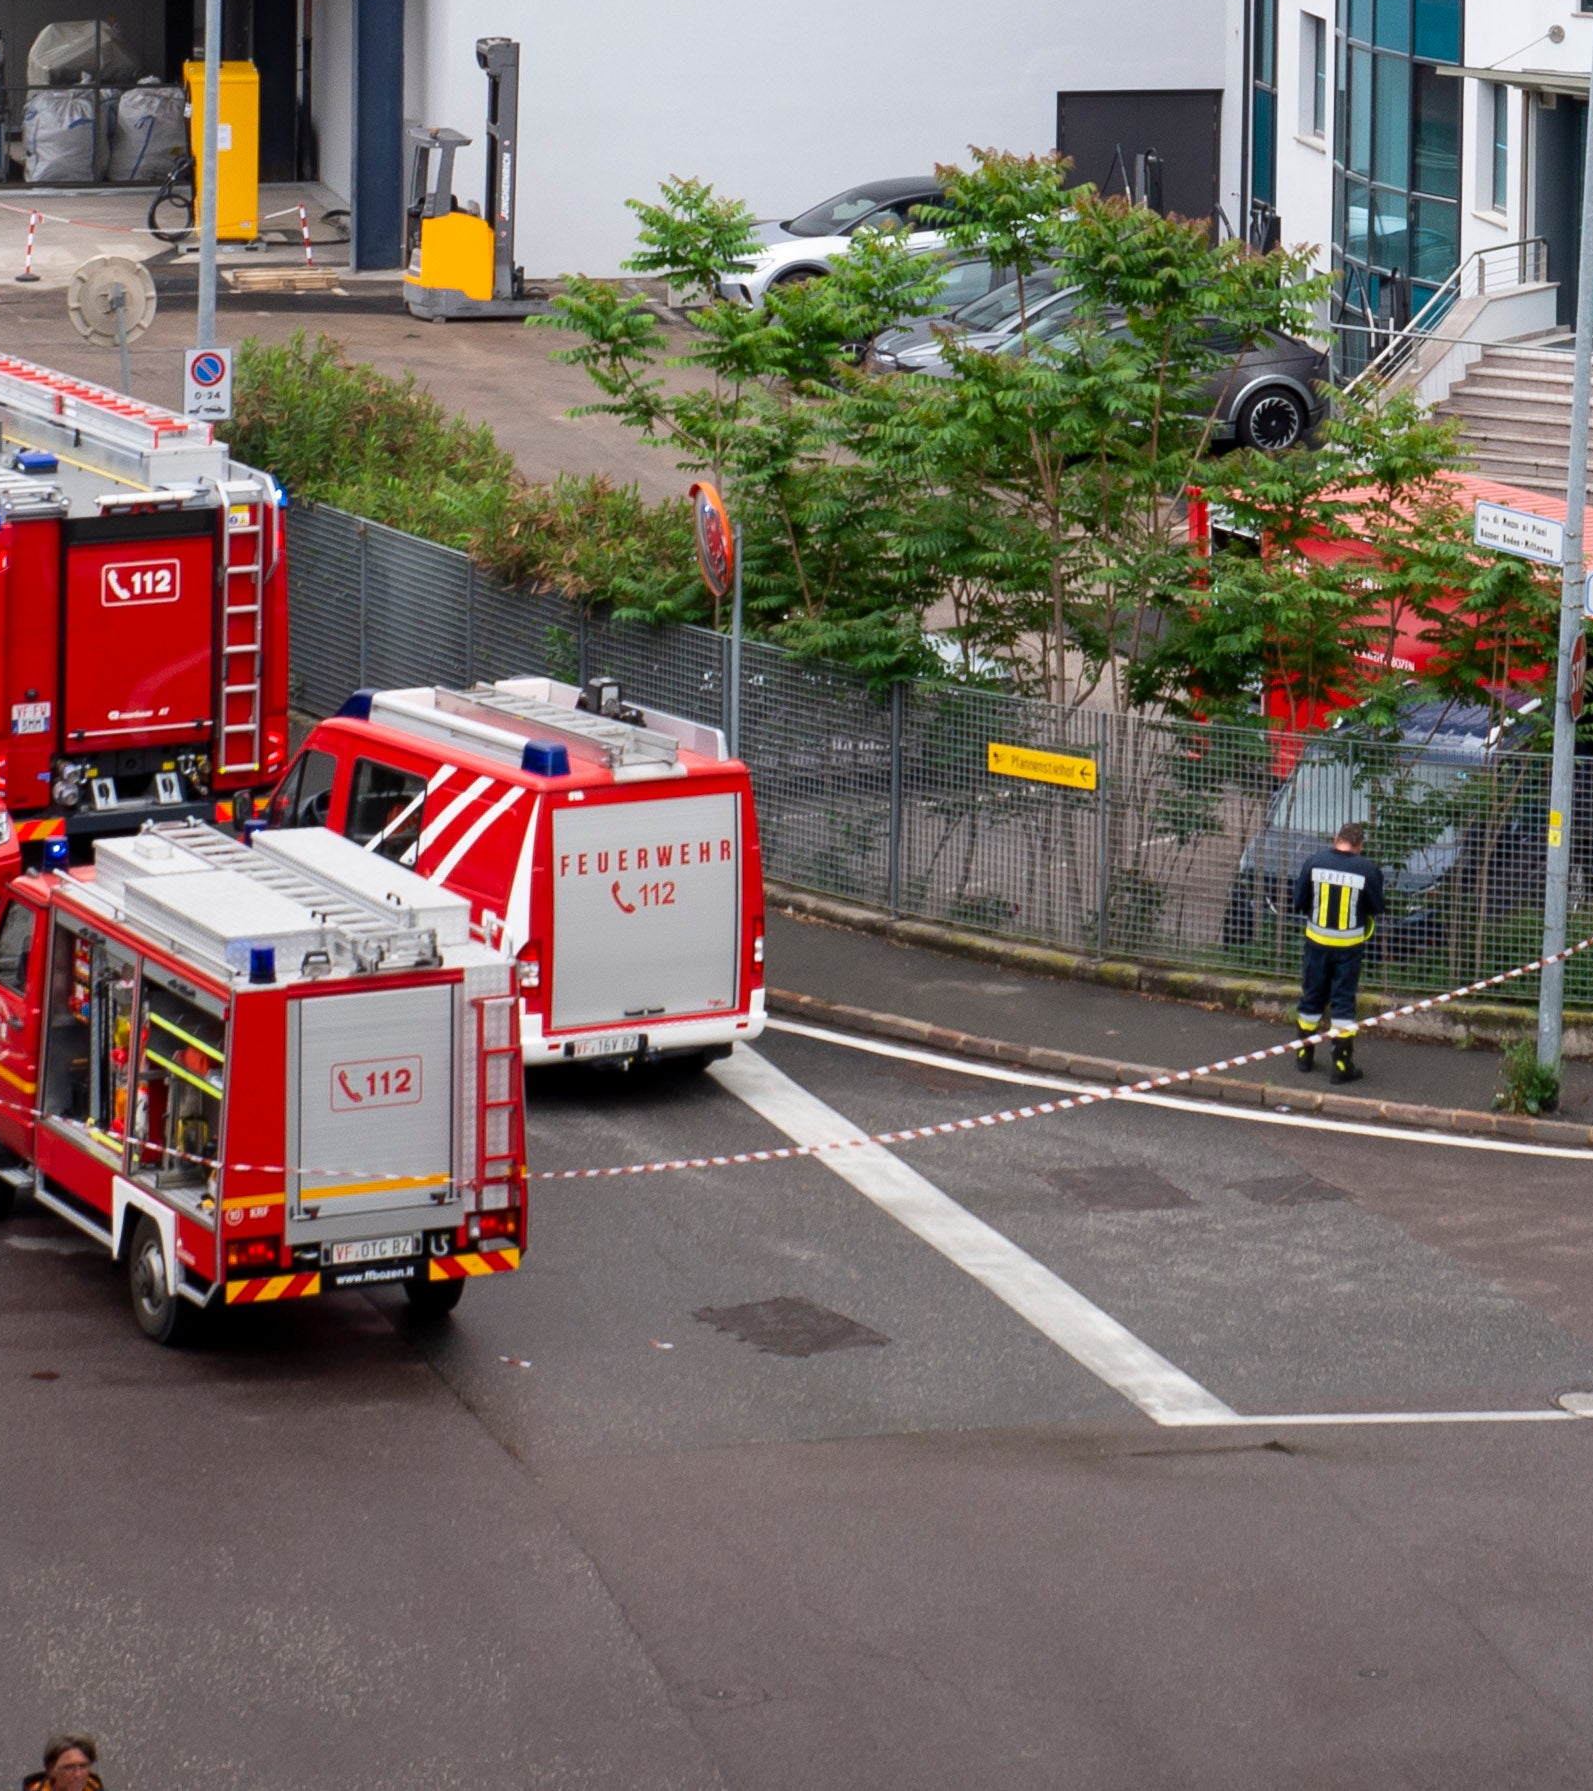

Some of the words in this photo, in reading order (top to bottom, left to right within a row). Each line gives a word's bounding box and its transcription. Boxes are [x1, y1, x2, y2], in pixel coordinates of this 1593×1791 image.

[1532, 524, 1548, 538] Piani
[131, 569, 172, 595] 112
[560, 839, 732, 877] FEUERWEHR
[639, 881, 676, 907] 112
[575, 1038, 589, 1055] VF
[622, 1035, 637, 1050] BZ
[366, 1068, 412, 1097] 112
[336, 1244, 353, 1261] VF
[392, 1236, 410, 1255] BZ
[335, 1264, 415, 1286] www.ffbozen.it
